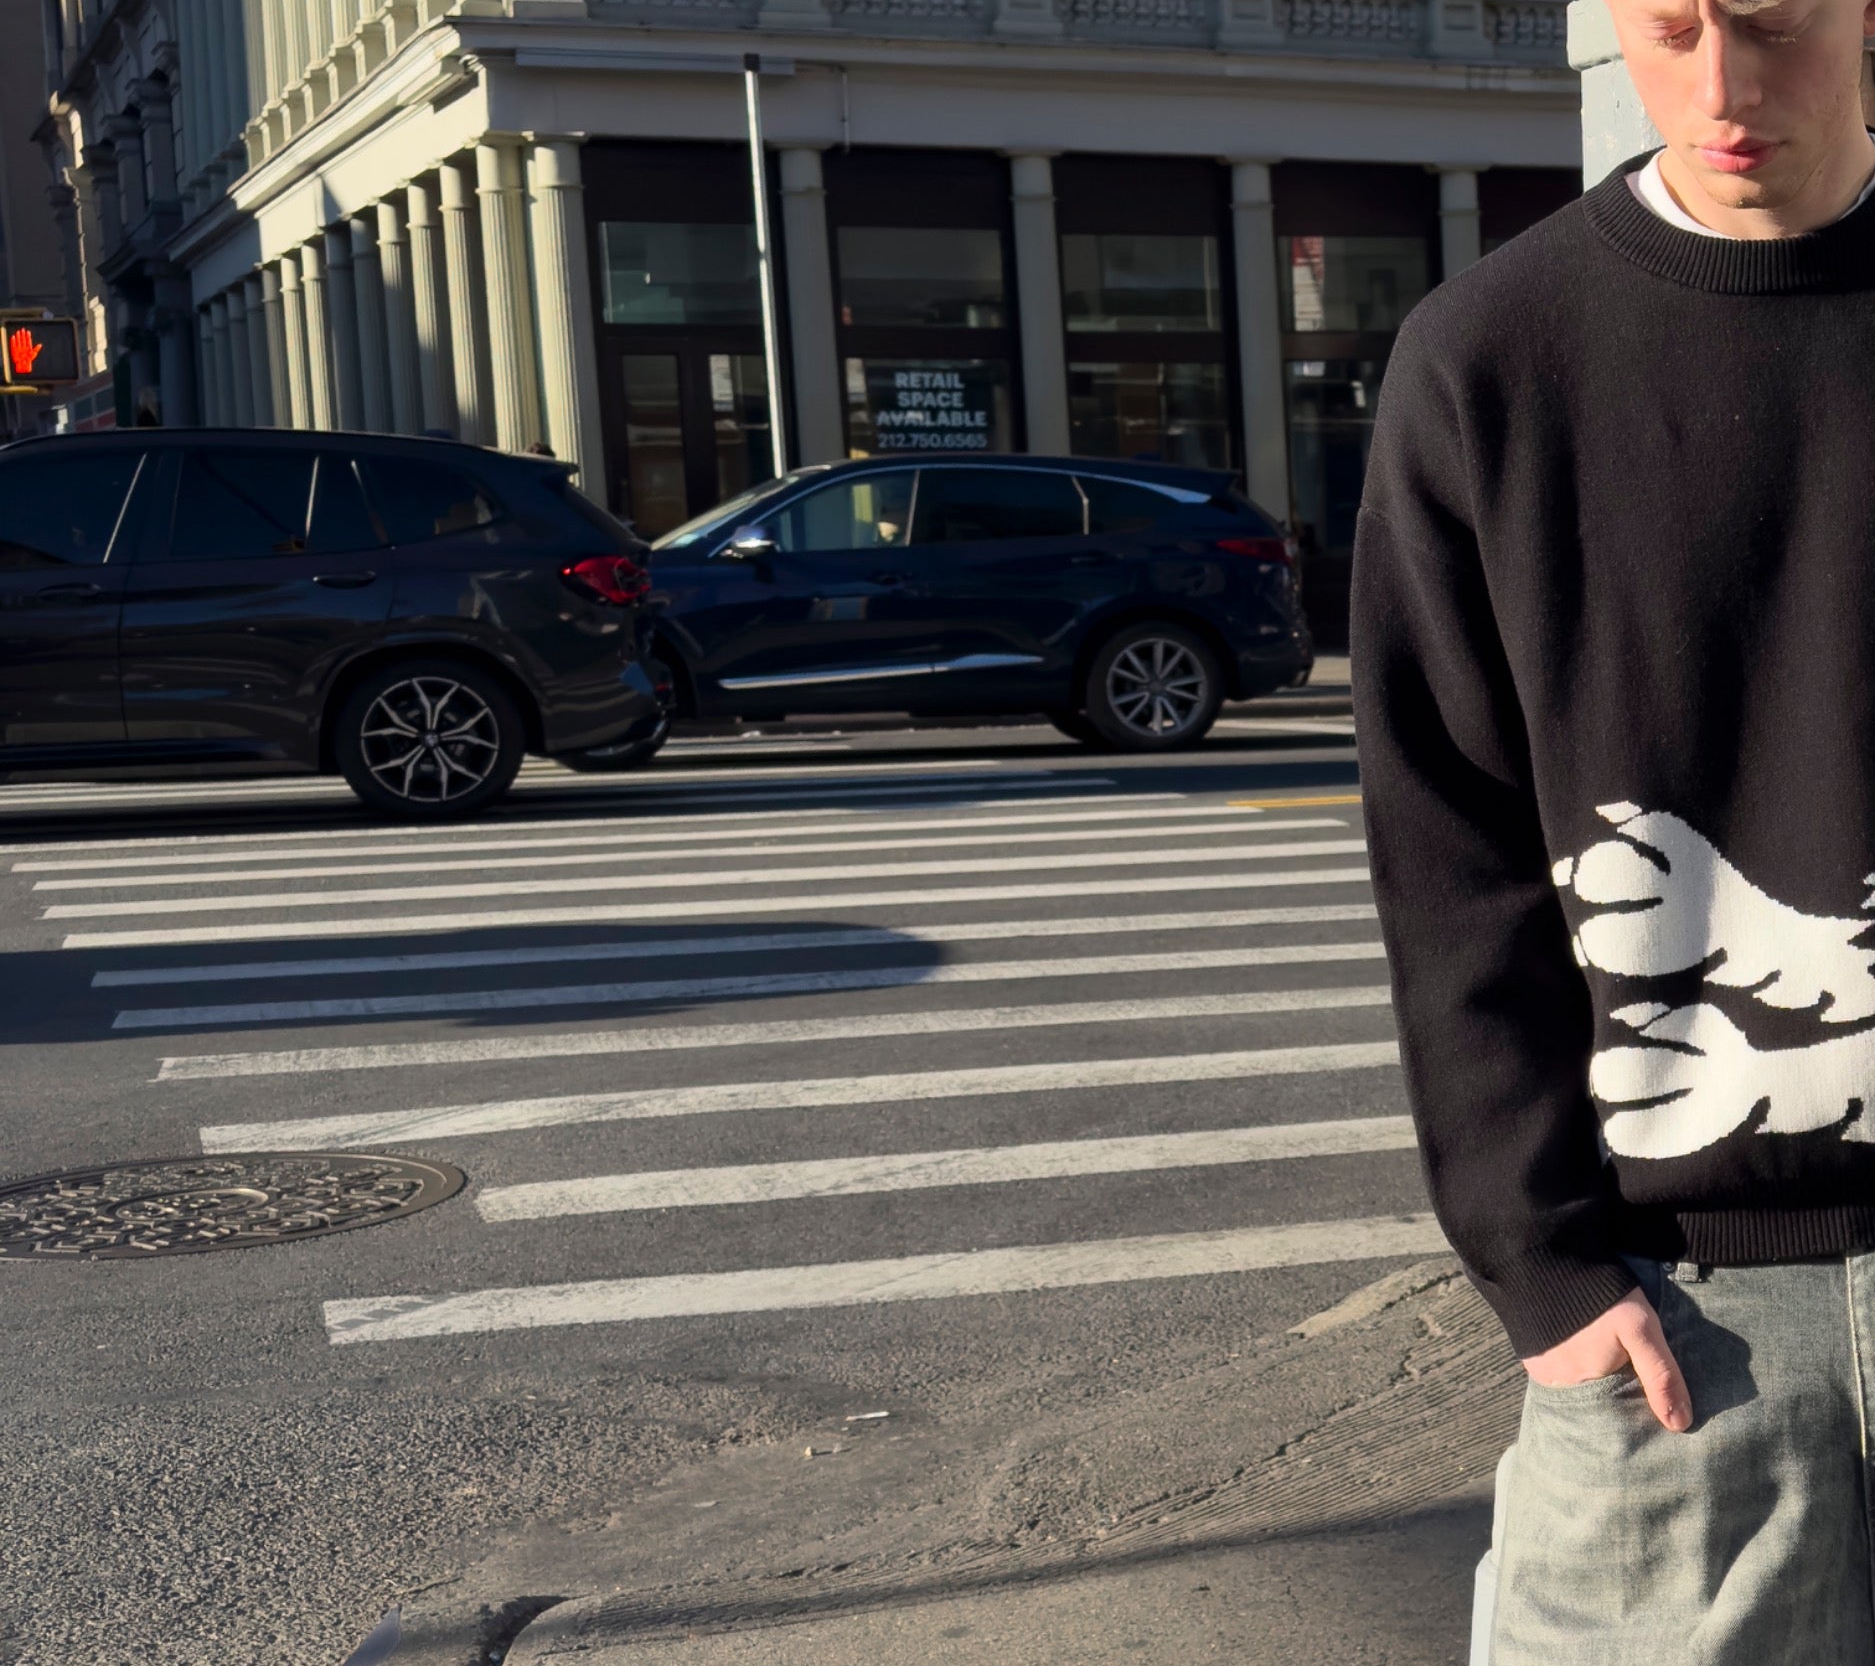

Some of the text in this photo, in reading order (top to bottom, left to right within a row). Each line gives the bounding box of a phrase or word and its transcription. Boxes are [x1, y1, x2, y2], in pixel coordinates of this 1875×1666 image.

[894, 372, 965, 389] RETAIL
[898, 391, 964, 407] SPACE
[876, 410, 987, 426] AVAILABLE
